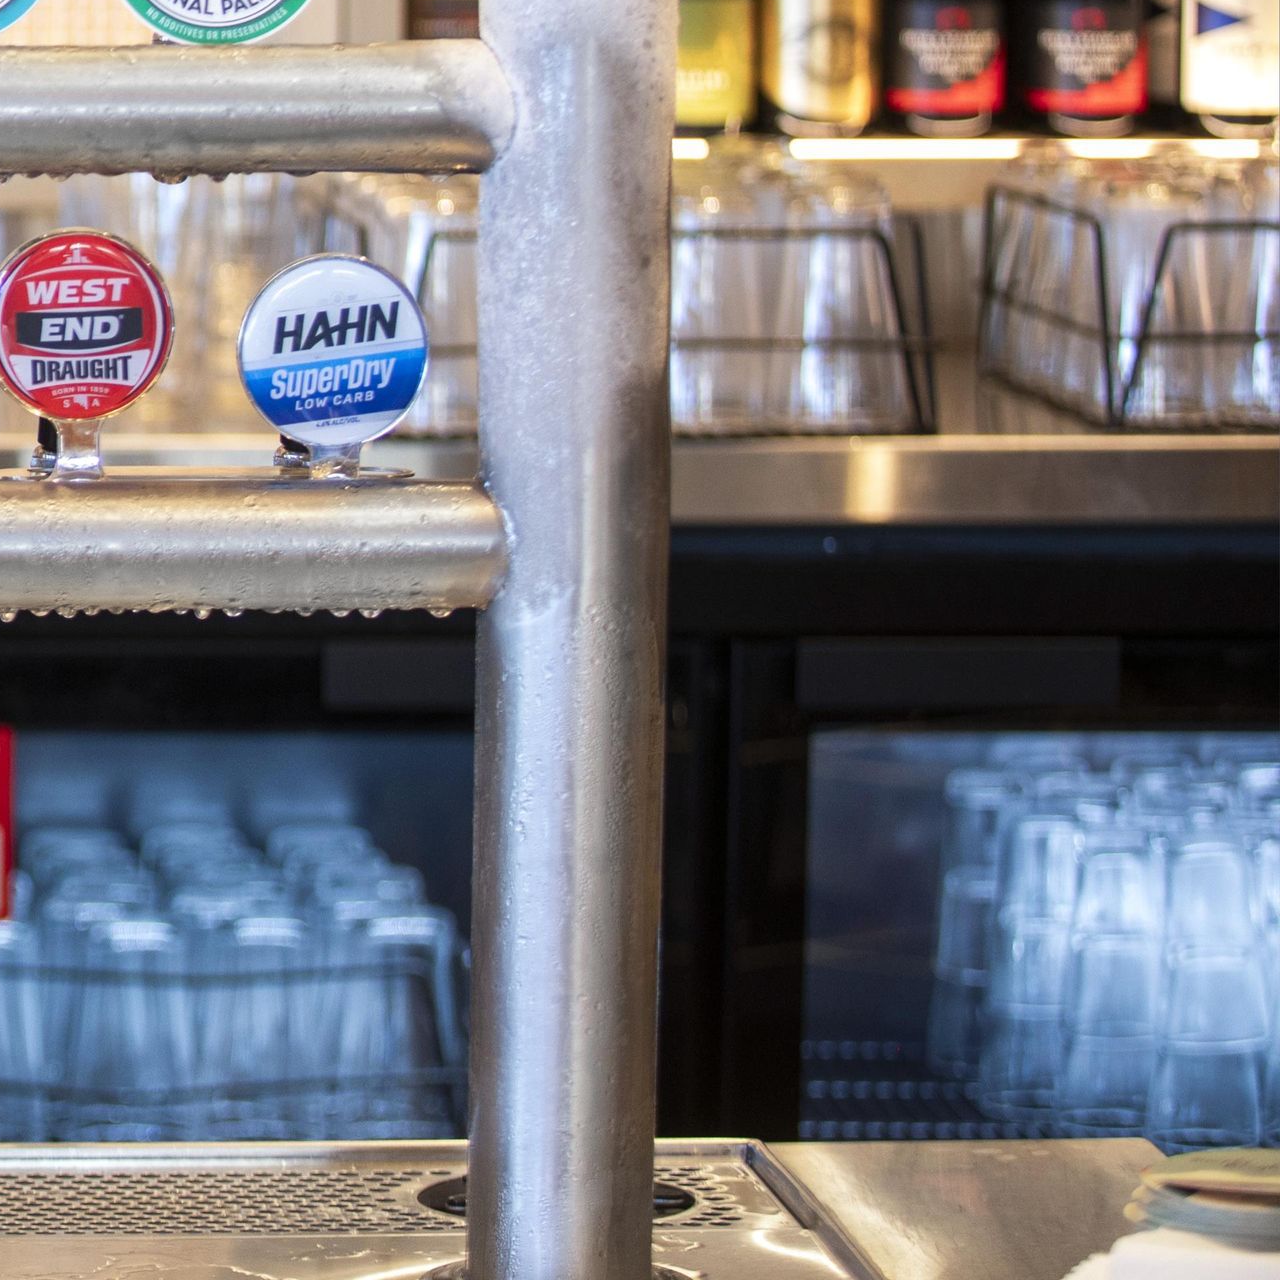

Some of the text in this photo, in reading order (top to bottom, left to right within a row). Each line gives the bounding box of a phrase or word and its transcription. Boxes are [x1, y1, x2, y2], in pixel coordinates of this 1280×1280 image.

[146, 7, 288, 40] NO ADDITIVES OR PRESERVATIVES
[26, 277, 130, 305] WEST
[40, 315, 120, 342] END
[273, 301, 399, 354] HAHN
[31, 355, 132, 385] DRAUGHT
[270, 357, 397, 399] SuperDry
[51, 386, 74, 396] BORN
[63, 398, 100, 408] S A
[295, 391, 375, 411] LOW CARB
